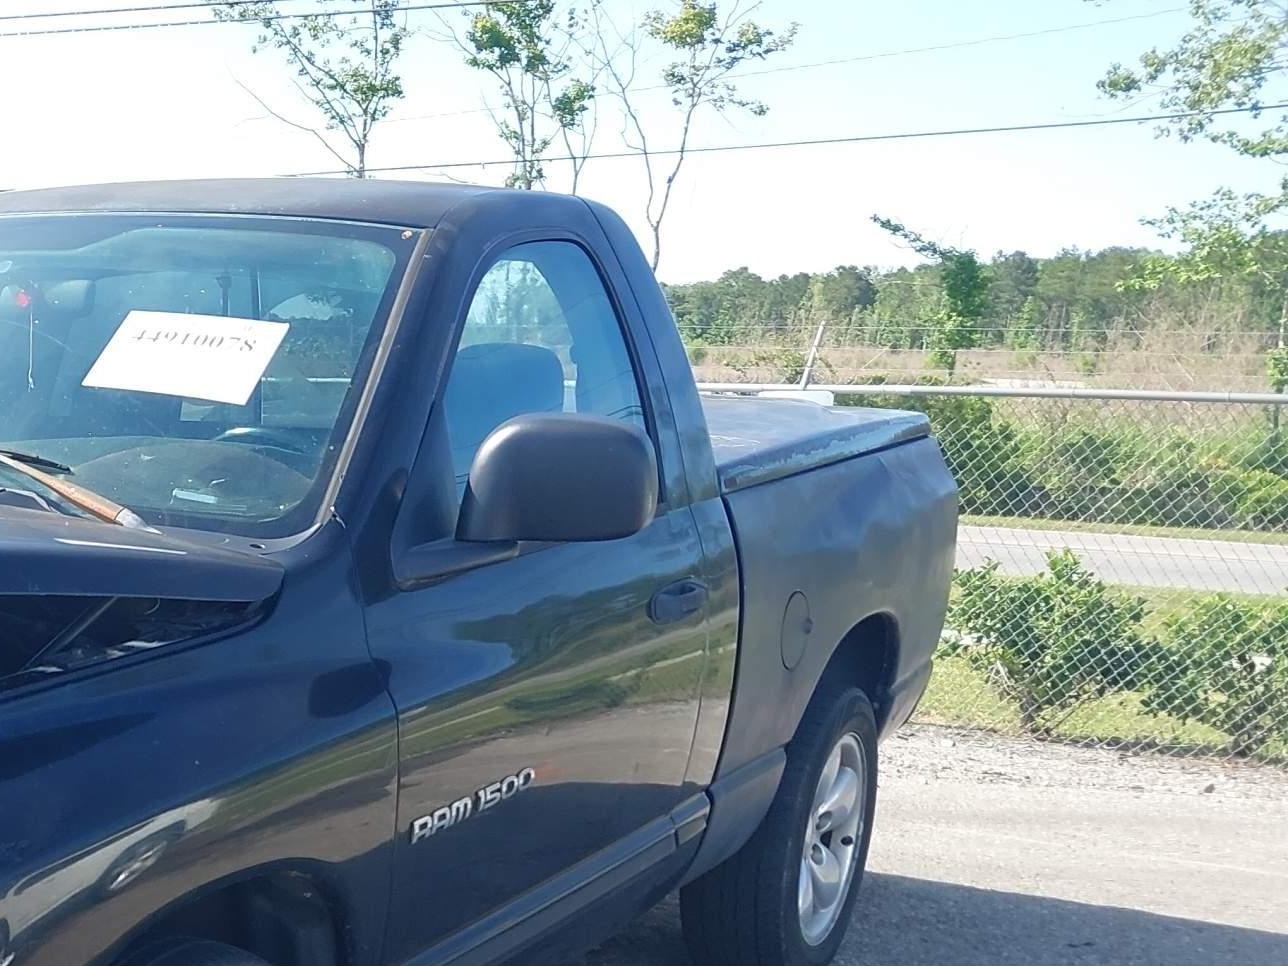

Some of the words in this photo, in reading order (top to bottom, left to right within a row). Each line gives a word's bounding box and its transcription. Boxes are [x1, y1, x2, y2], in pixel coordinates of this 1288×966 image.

[131, 329, 257, 352] 44910078
[411, 797, 472, 845] RAM
[476, 767, 536, 812] 1500
